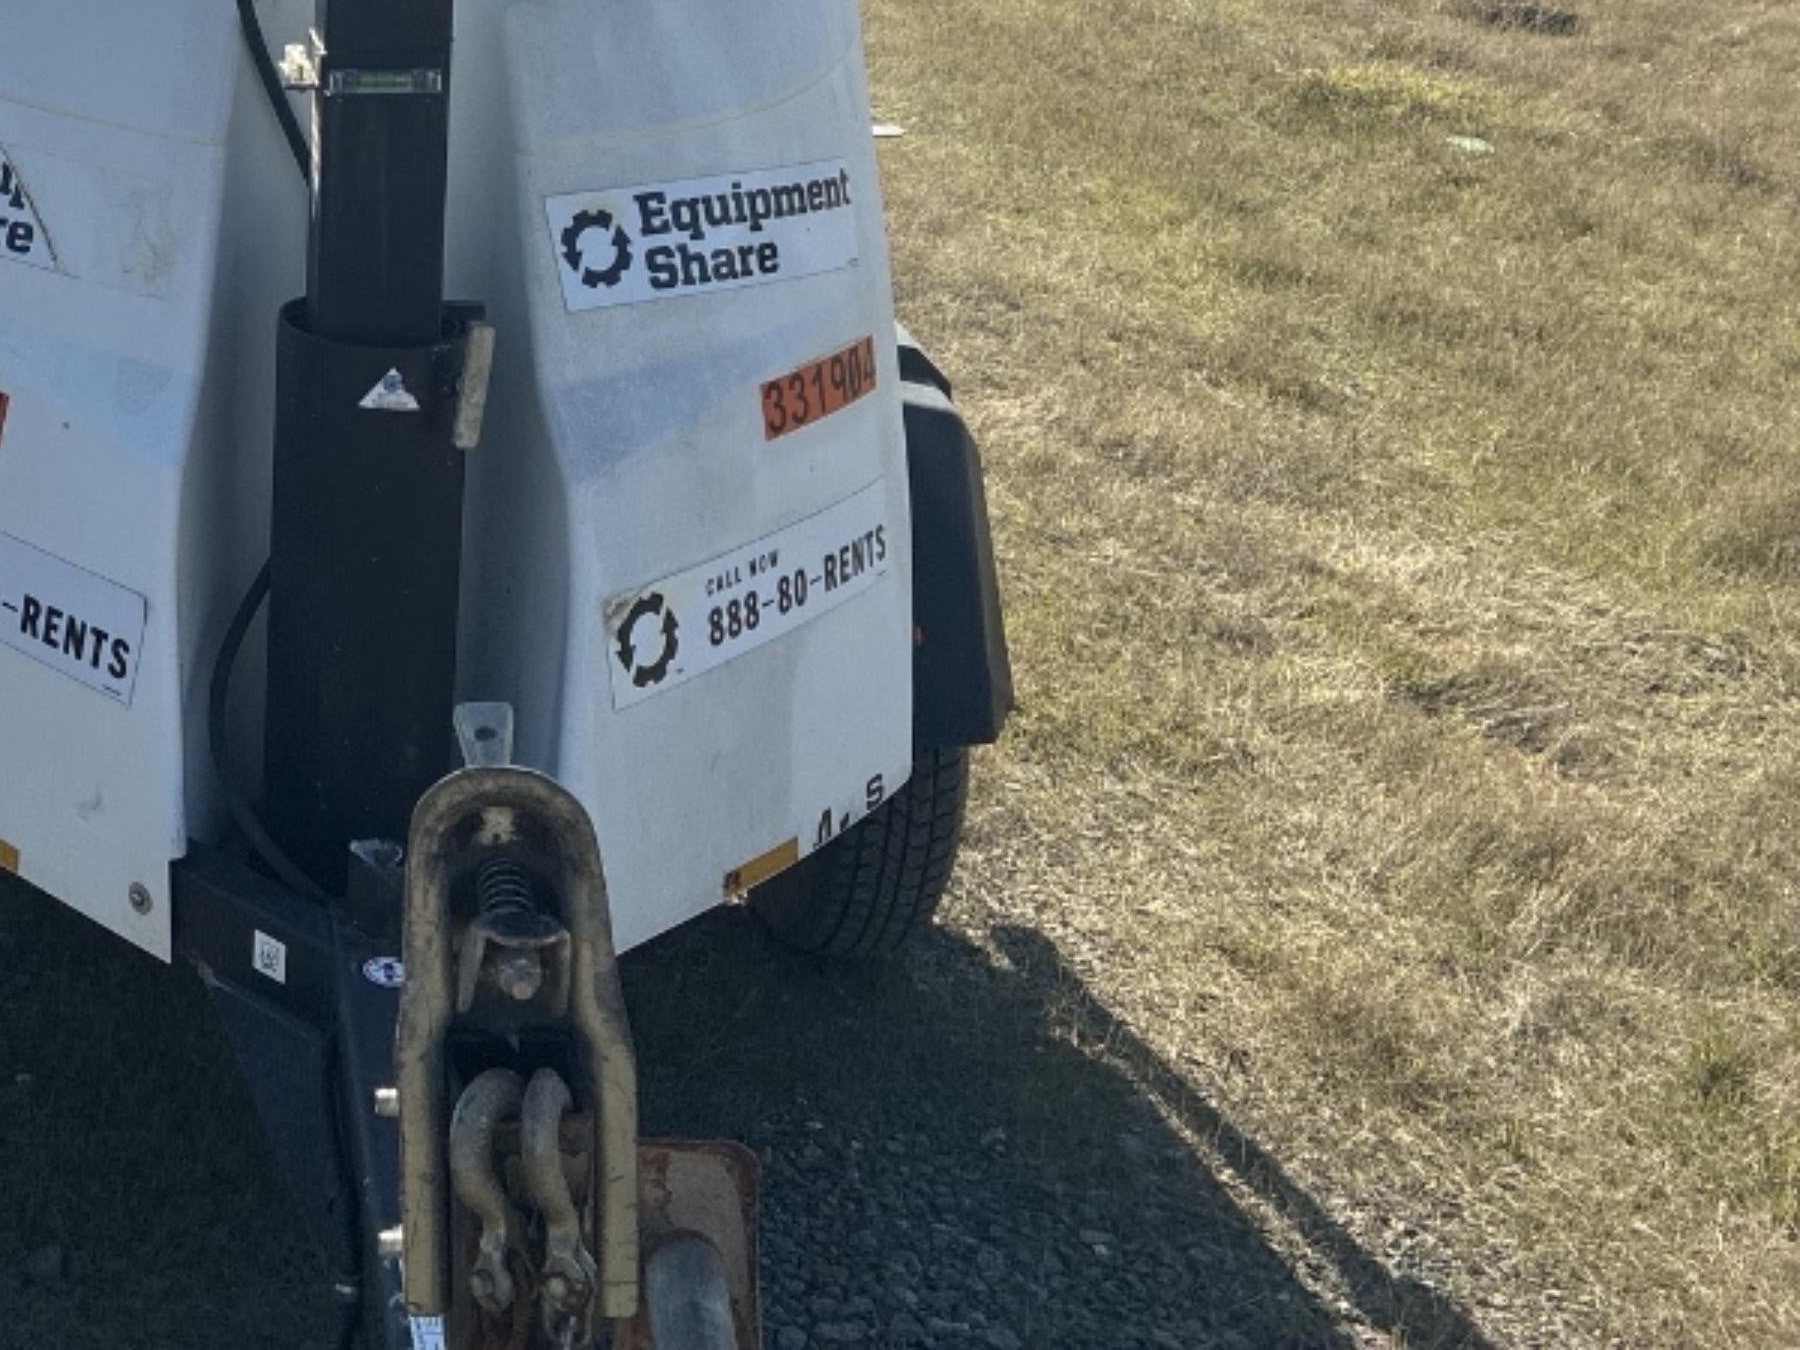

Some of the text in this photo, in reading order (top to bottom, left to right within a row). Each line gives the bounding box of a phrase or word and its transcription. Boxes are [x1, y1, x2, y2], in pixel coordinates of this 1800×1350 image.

[633, 168, 853, 240] Equipment
[644, 241, 780, 290] Share
[764, 337, 876, 433] 331904
[705, 549, 779, 597] CALL NOW
[708, 523, 887, 646] 888-80-RENTS
